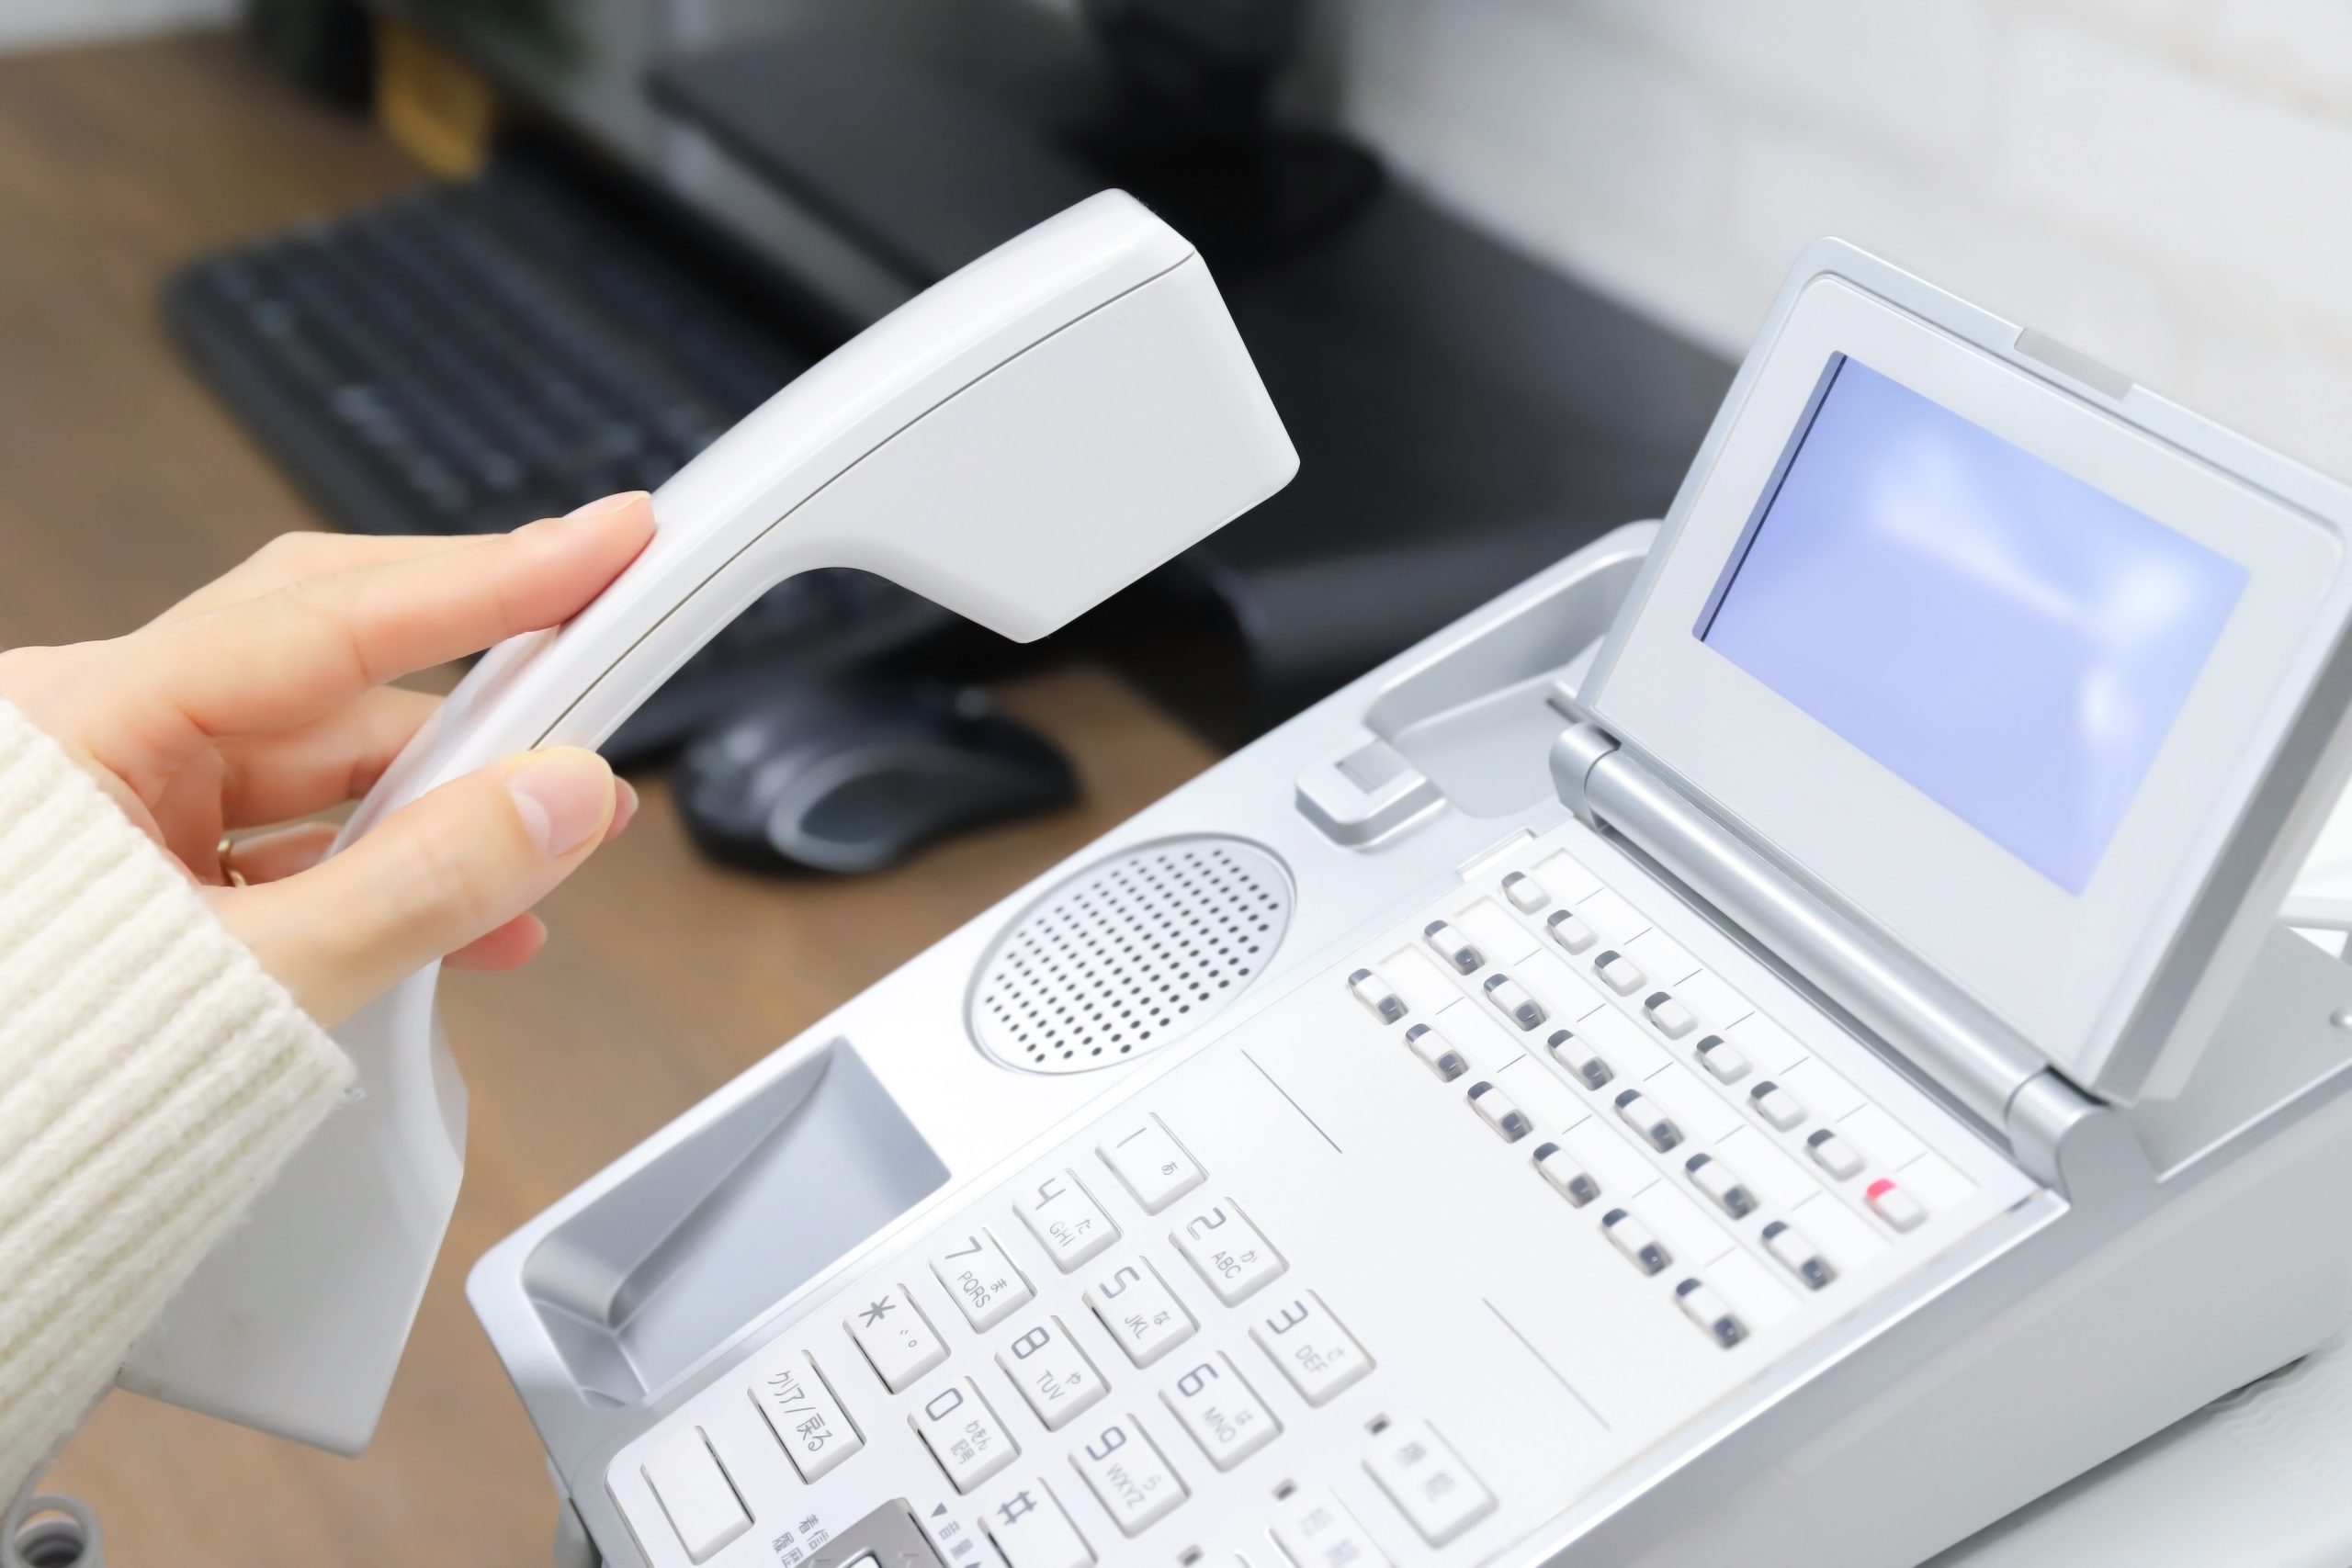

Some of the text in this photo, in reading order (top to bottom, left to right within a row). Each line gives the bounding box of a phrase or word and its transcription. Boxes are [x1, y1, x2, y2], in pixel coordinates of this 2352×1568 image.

[1160, 1161, 1179, 1177] あ
[1035, 1177, 1067, 1211] 4
[1048, 1220, 1077, 1247] GHI
[1073, 1218, 1092, 1235] た
[1186, 1206, 1227, 1242] 2
[944, 1235, 983, 1260] 7
[1238, 1249, 1258, 1264] か
[1210, 1250, 1242, 1280] ABC
[956, 1269, 991, 1308] PQRS
[989, 1278, 1009, 1293] ま
[1098, 1265, 1141, 1300] 5
[1124, 1313, 1149, 1340] JKL
[1153, 1310, 1171, 1326] な
[1265, 1299, 1309, 1336] 3
[1011, 1325, 1051, 1360] 8
[1295, 1344, 1329, 1374] DEF
[1035, 1370, 1066, 1401] TUV
[1065, 1371, 1082, 1386] や
[1177, 1362, 1219, 1398] 6
[766, 1370, 833, 1452] クリア/戻る
[924, 1387, 964, 1422] 0
[1202, 1405, 1238, 1443] MNO
[1084, 1426, 1127, 1461] 9
[1105, 1461, 1147, 1509] WXYZ
[996, 1490, 1038, 1527] #
[797, 1513, 831, 1551] 着信
